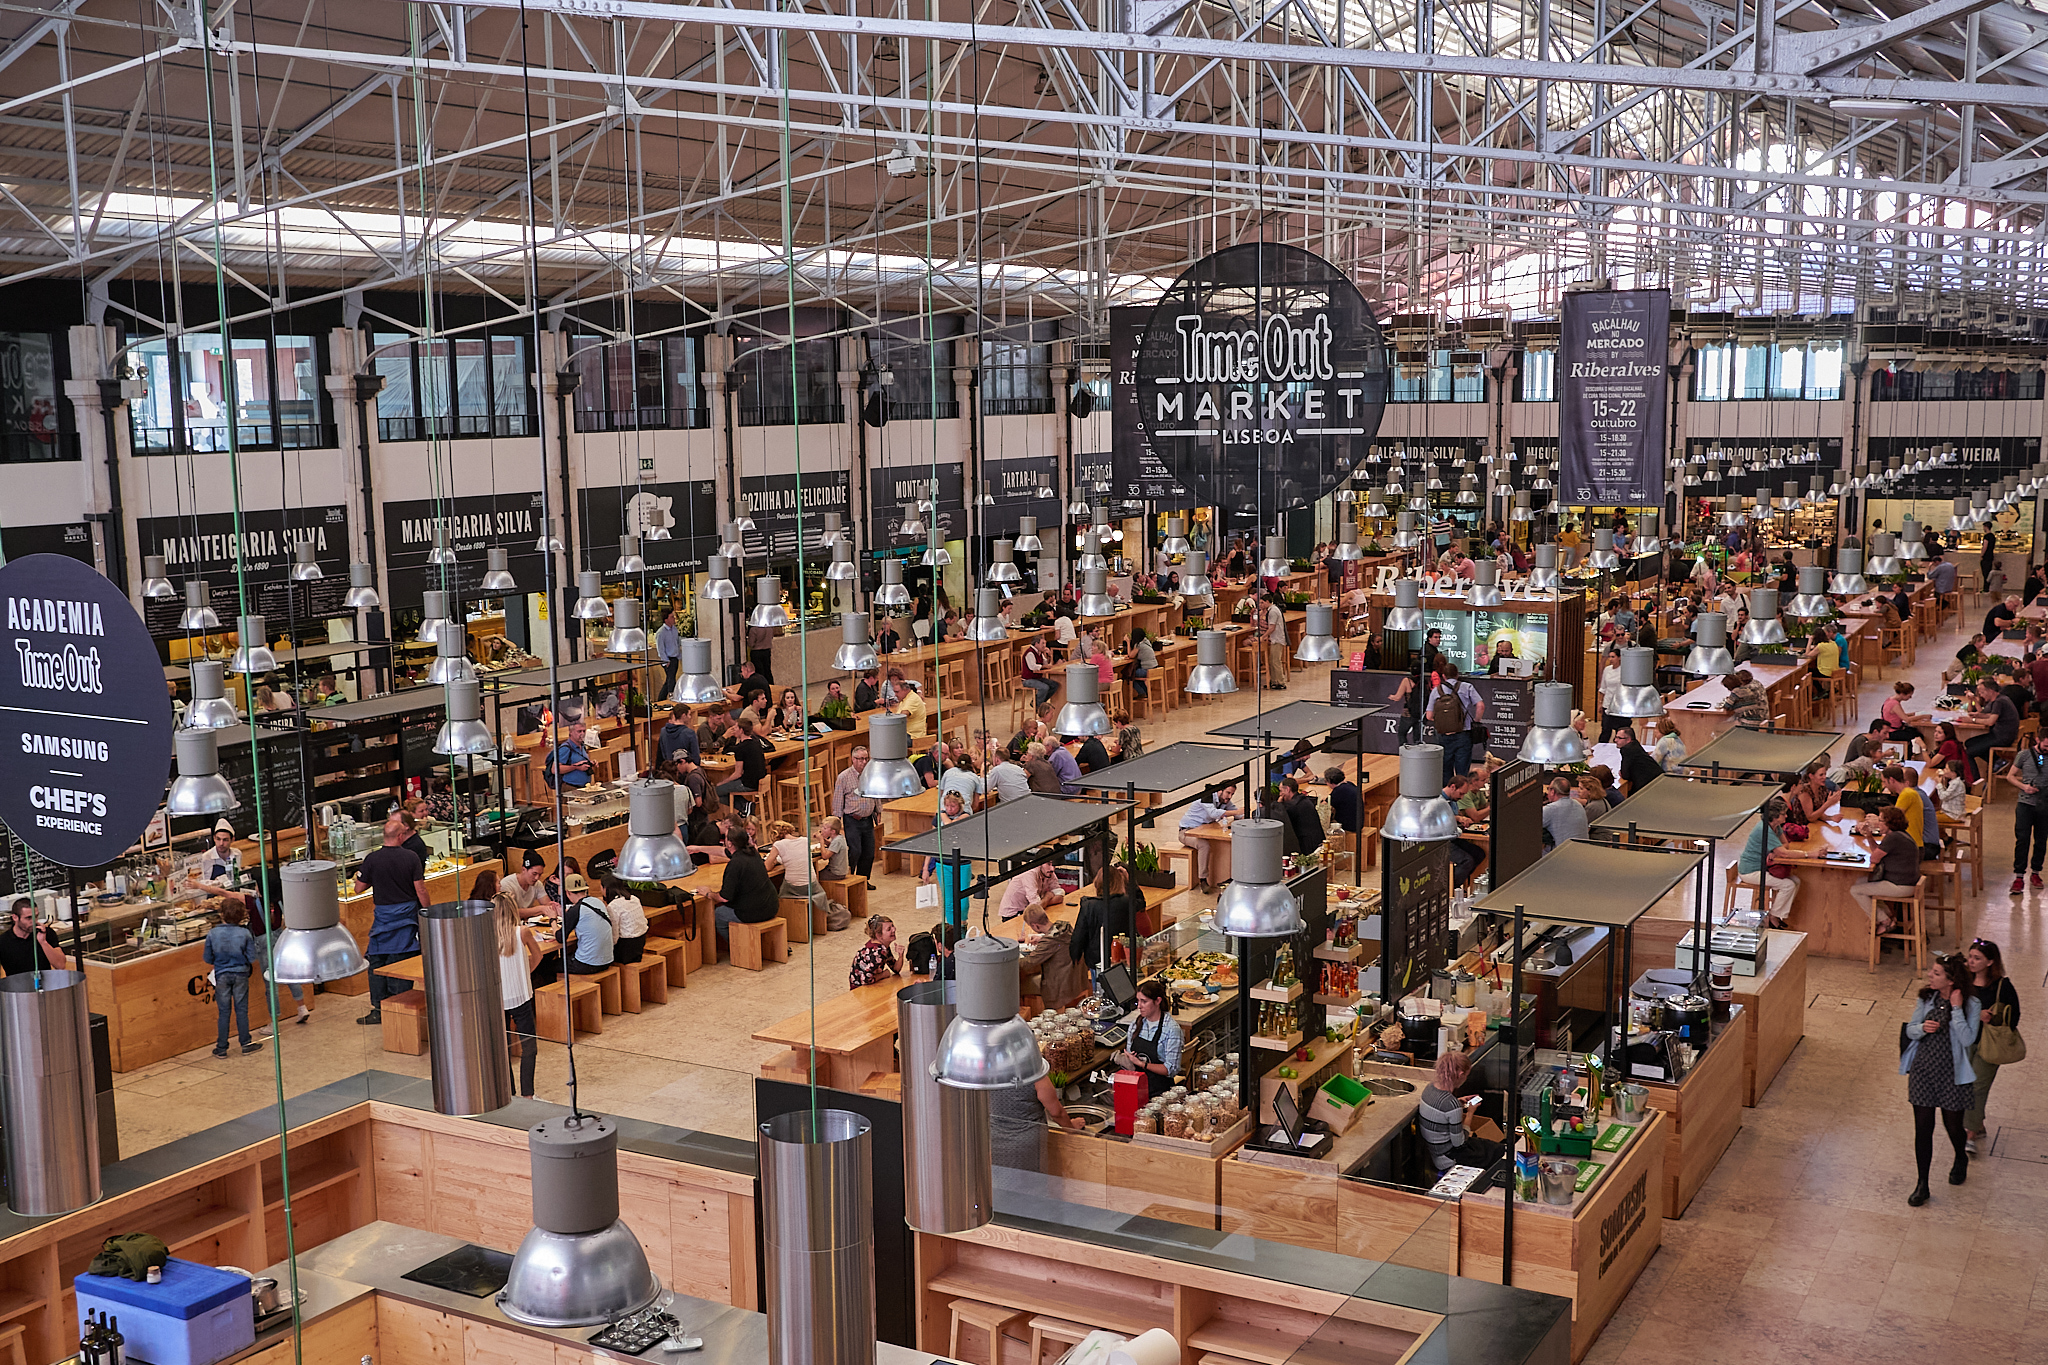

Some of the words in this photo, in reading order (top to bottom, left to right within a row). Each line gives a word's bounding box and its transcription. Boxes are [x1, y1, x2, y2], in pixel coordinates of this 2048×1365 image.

[1591, 318, 1640, 334] BACALHAU
[1611, 330, 1620, 338] NO
[1586, 339, 1645, 349] MERCADO
[1611, 351, 1619, 359] BY
[1570, 361, 1661, 378] Riberalves
[1157, 388, 1363, 421] MARKET
[1590, 418, 1637, 428] outubro
[1222, 429, 1295, 444] LISBOA
[1962, 447, 2000, 462] VIEIRA
[1002, 470, 1038, 489] TARTAR-IA
[784, 489, 797, 509] DA
[496, 510, 533, 535] SILVA
[8, 597, 105, 637] ACADEMIA
[21, 733, 109, 762] SAMSUNG
[29, 785, 107, 817] CHEF'S
[36, 814, 103, 836] EXPERIENCE
